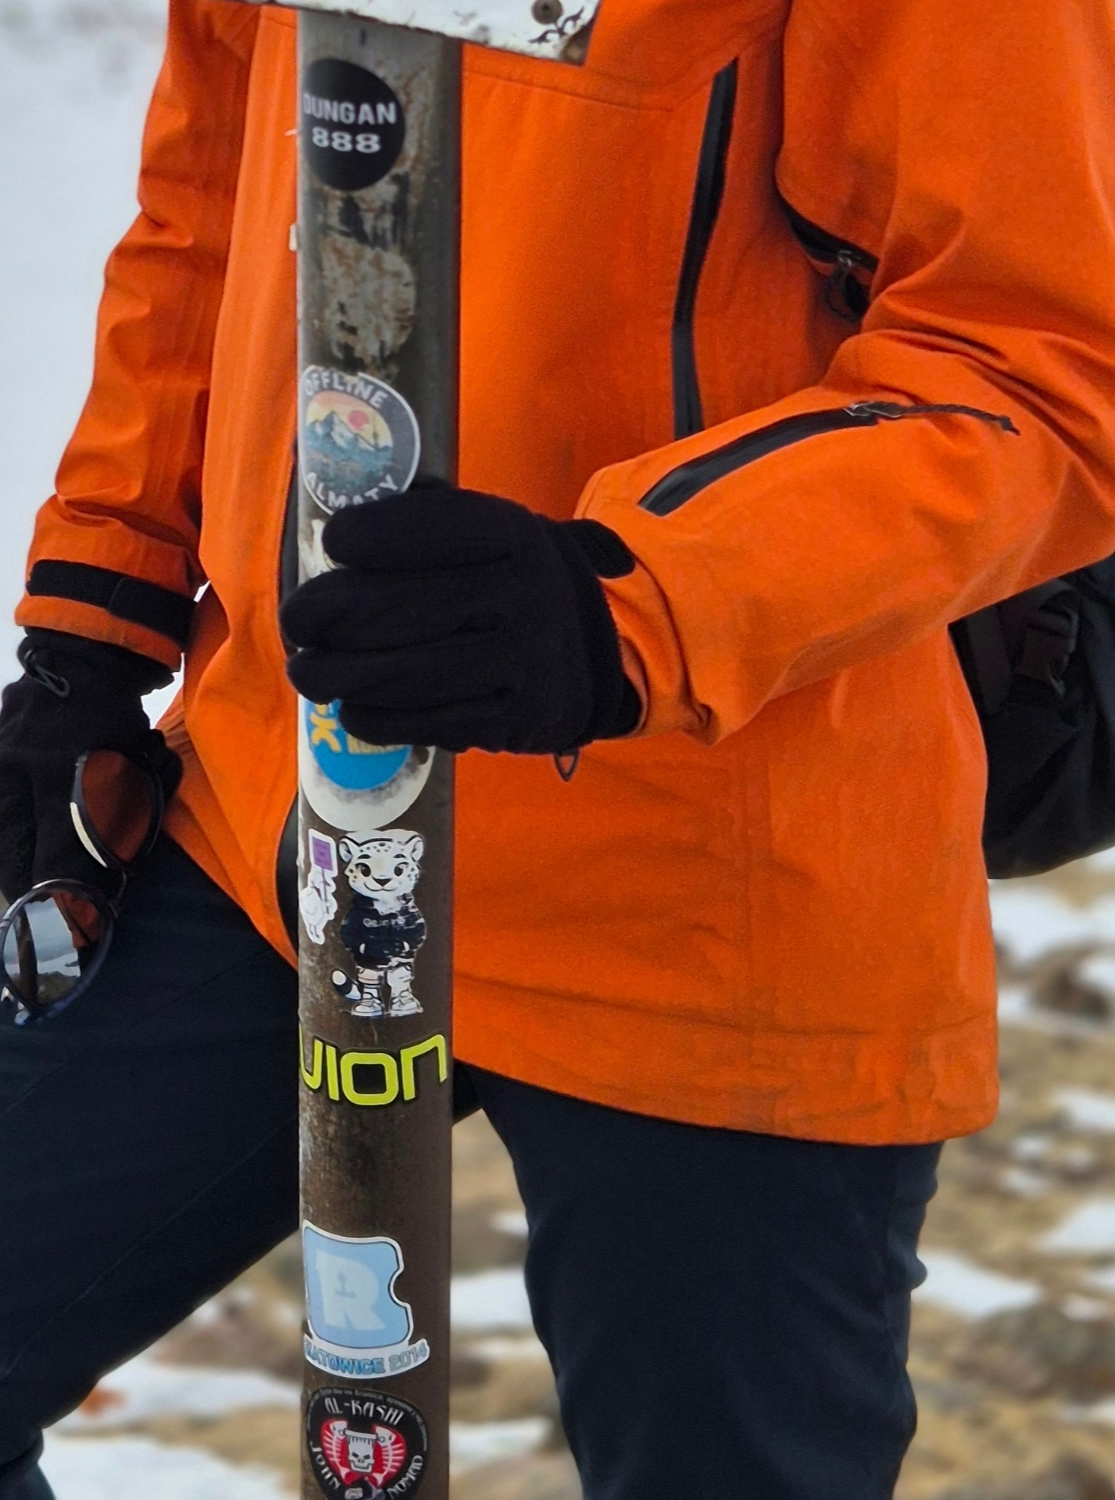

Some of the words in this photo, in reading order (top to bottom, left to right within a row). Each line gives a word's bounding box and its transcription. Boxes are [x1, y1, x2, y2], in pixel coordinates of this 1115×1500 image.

[303, 92, 397, 125] DUNGAN
[312, 126, 381, 153] 888
[305, 371, 389, 408] OFFLINE
